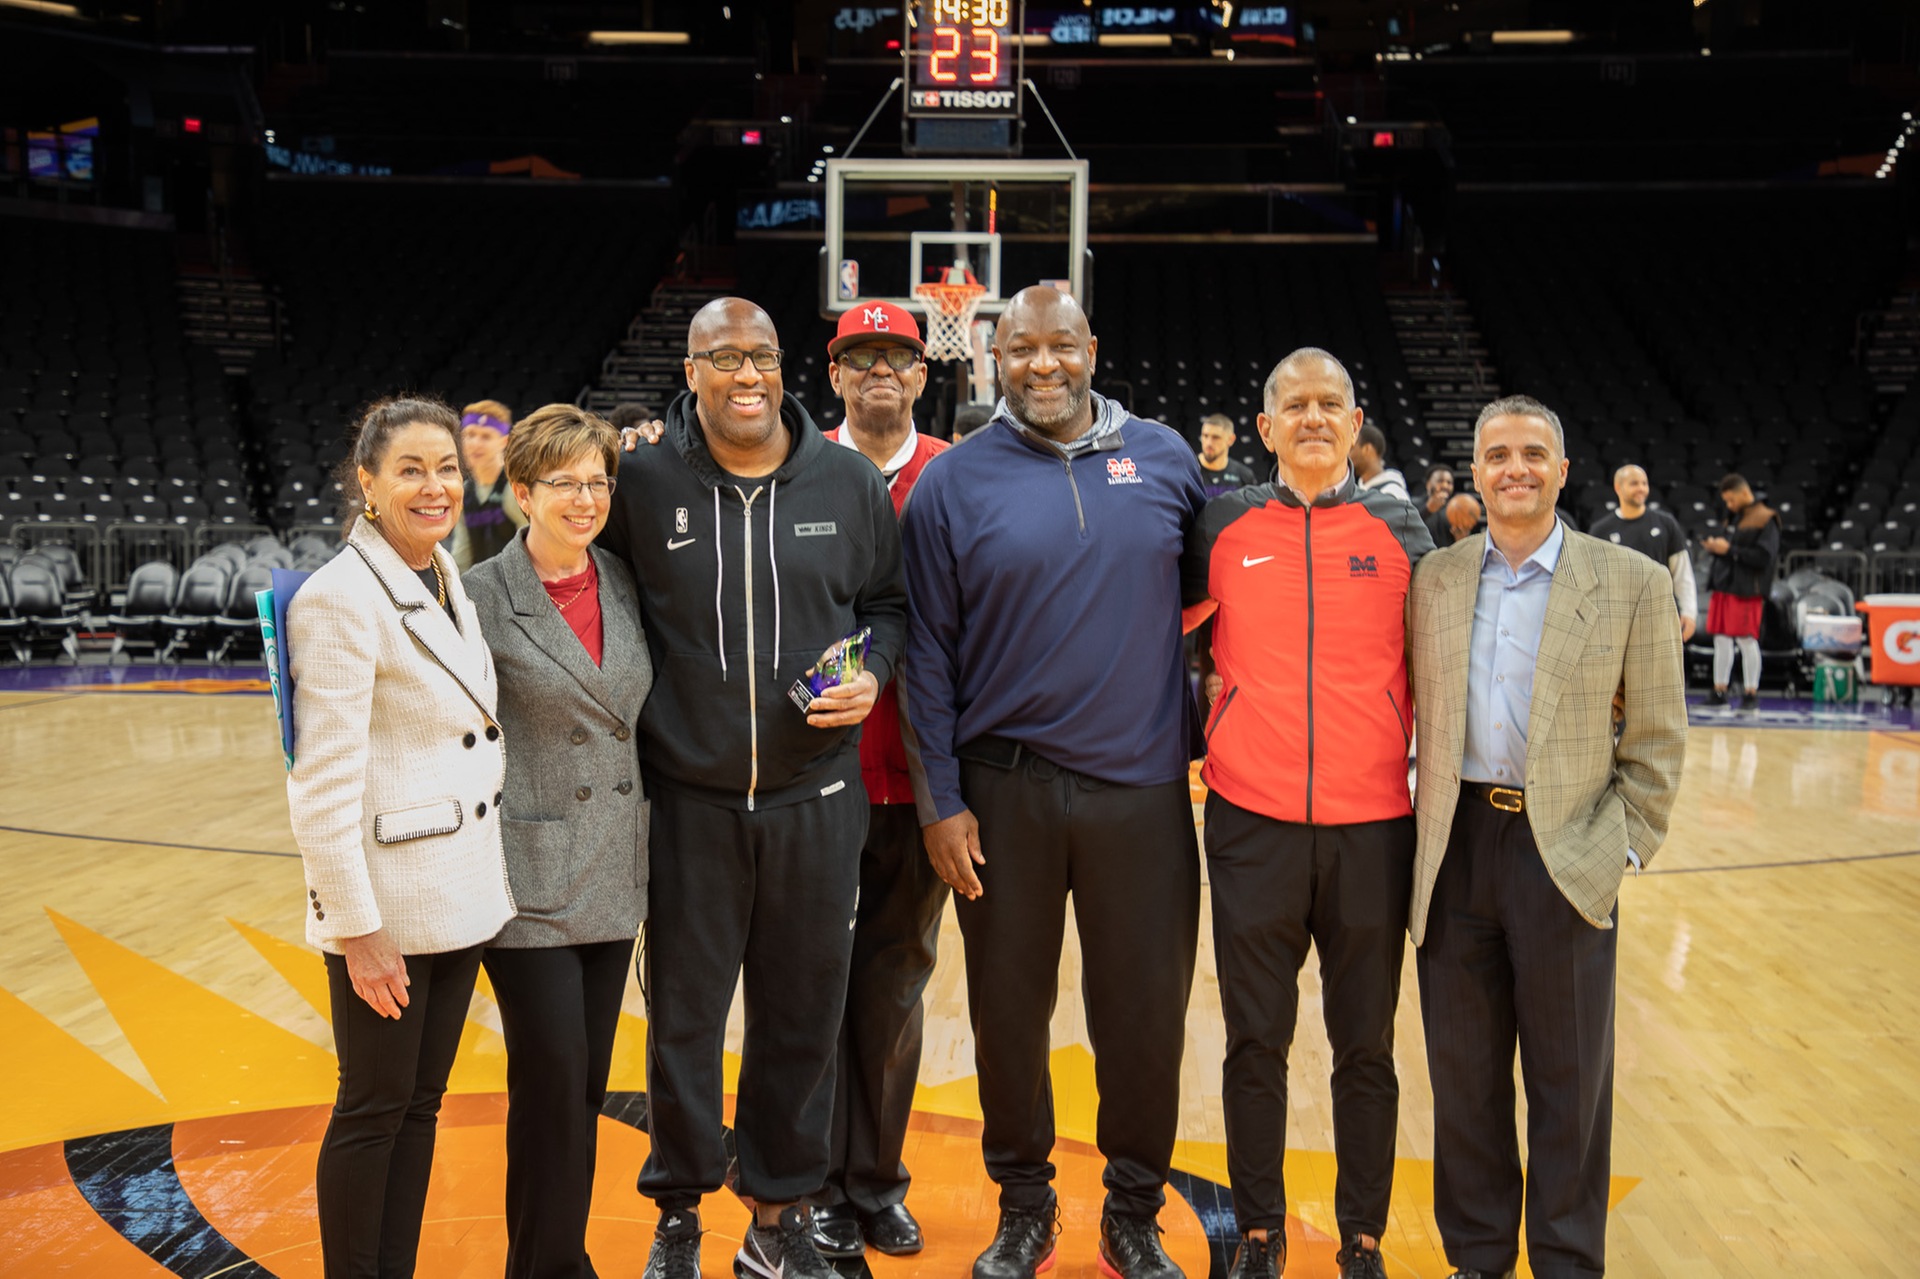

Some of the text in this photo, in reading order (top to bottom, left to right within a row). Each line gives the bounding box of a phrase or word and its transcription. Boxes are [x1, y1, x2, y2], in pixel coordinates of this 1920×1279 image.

[931, 27, 998, 82] 23
[939, 91, 1015, 108] TISSOT
[814, 524, 833, 533] KINGS
[1883, 619, 1920, 665] G
